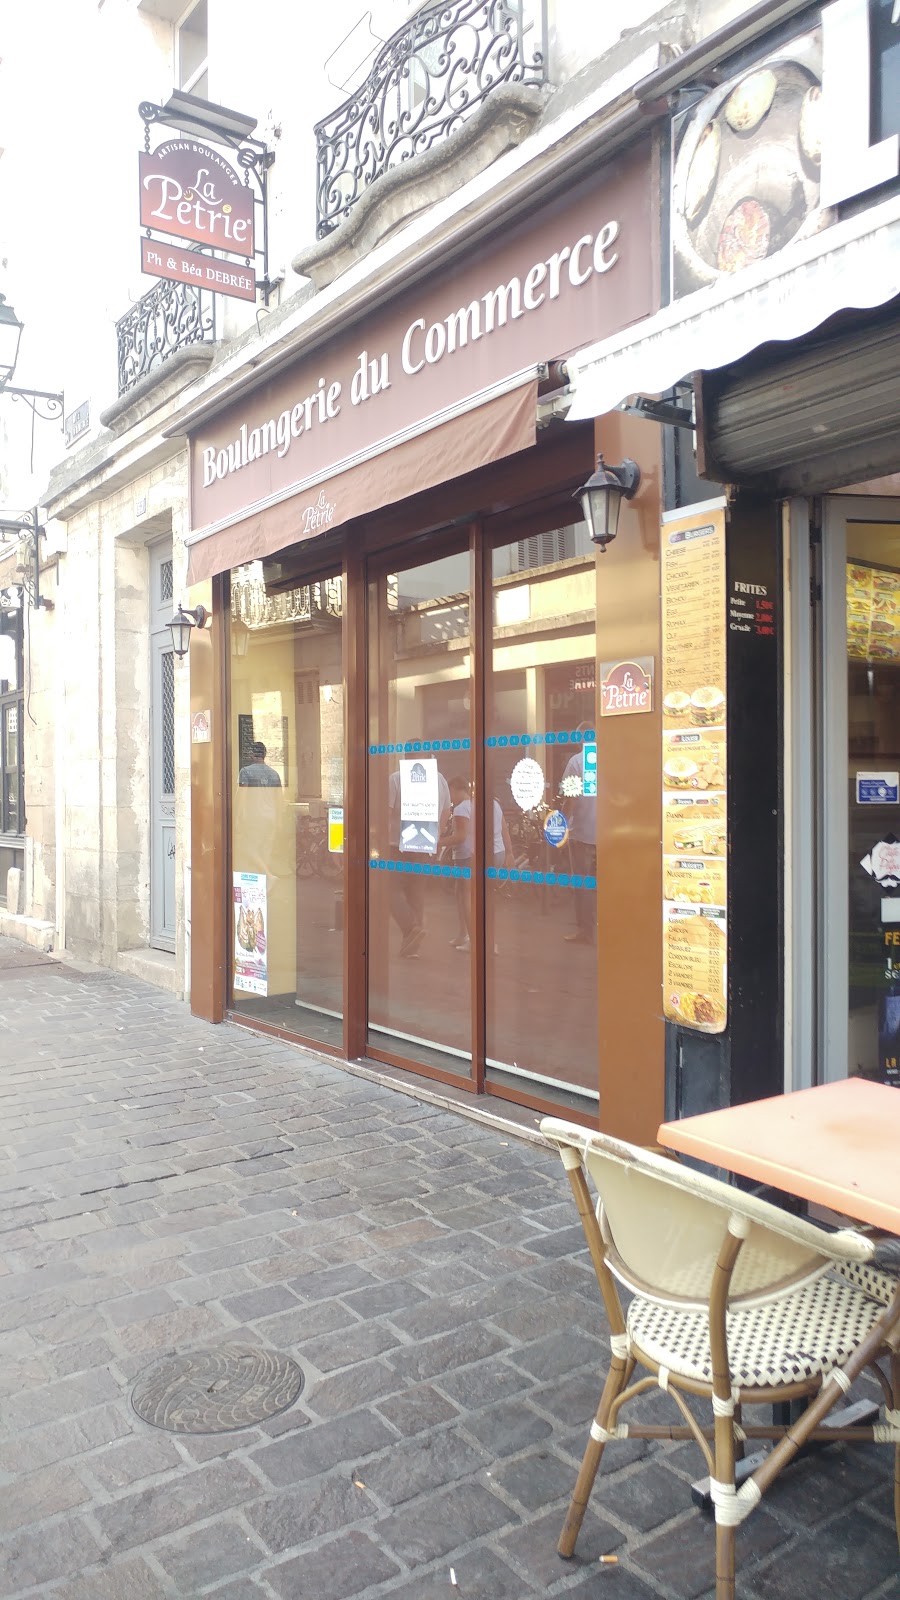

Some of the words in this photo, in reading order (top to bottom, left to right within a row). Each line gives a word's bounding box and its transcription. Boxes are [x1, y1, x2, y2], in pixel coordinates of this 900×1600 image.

[157, 143, 190, 159] ARTISAN
[192, 145, 238, 186] BOULANGER
[187, 168, 223, 206] La
[146, 251, 162, 267] Ph
[167, 258, 177, 270] &
[182, 261, 202, 277] Béa
[205, 268, 252, 291] DEBRÉE
[202, 378, 341, 488] Boulangerie
[350, 350, 391, 406] du
[401, 220, 621, 375] Commerce
[734, 581, 767, 596] FRITES
[620, 672, 636, 691] La
